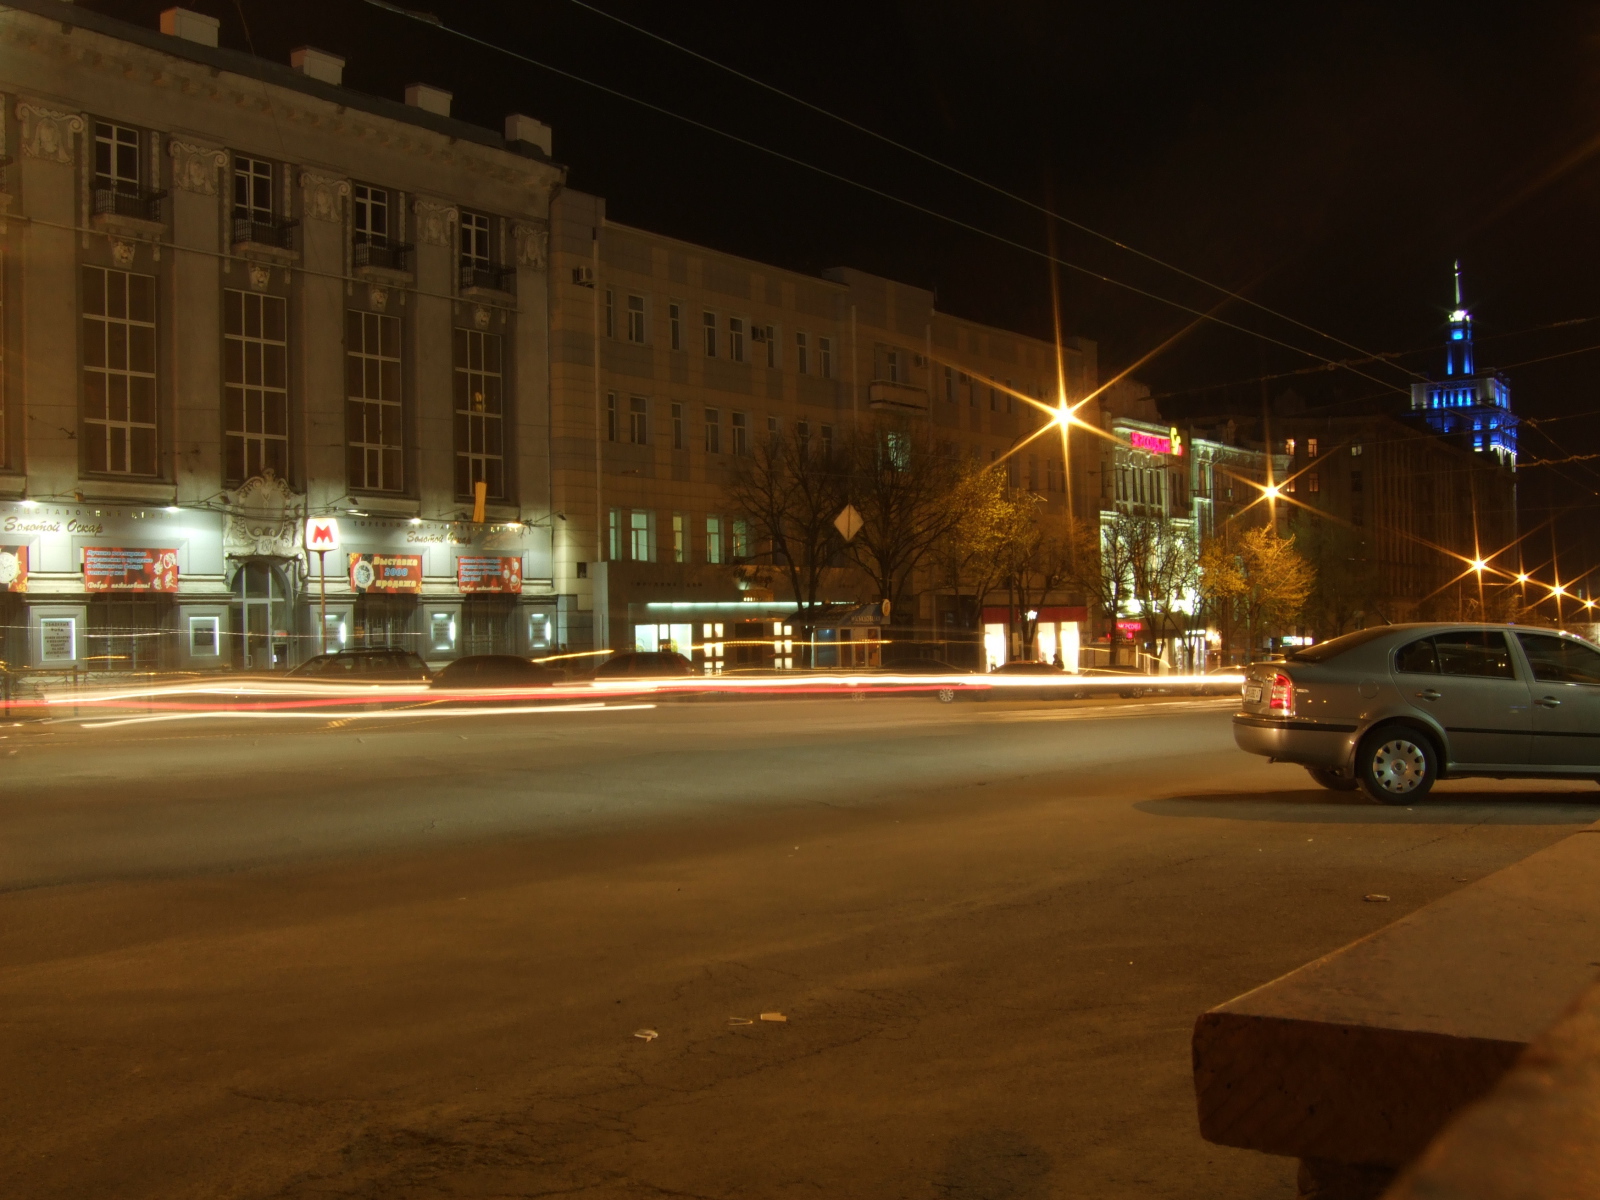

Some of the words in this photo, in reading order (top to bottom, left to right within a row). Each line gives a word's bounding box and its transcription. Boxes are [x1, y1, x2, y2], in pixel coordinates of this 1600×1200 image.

[4, 516, 61, 532] Золотой
[67, 518, 104, 537] Оскар
[407, 530, 443, 543] Золотой
[374, 556, 418, 566] Выставка
[376, 580, 417, 589] продажа
